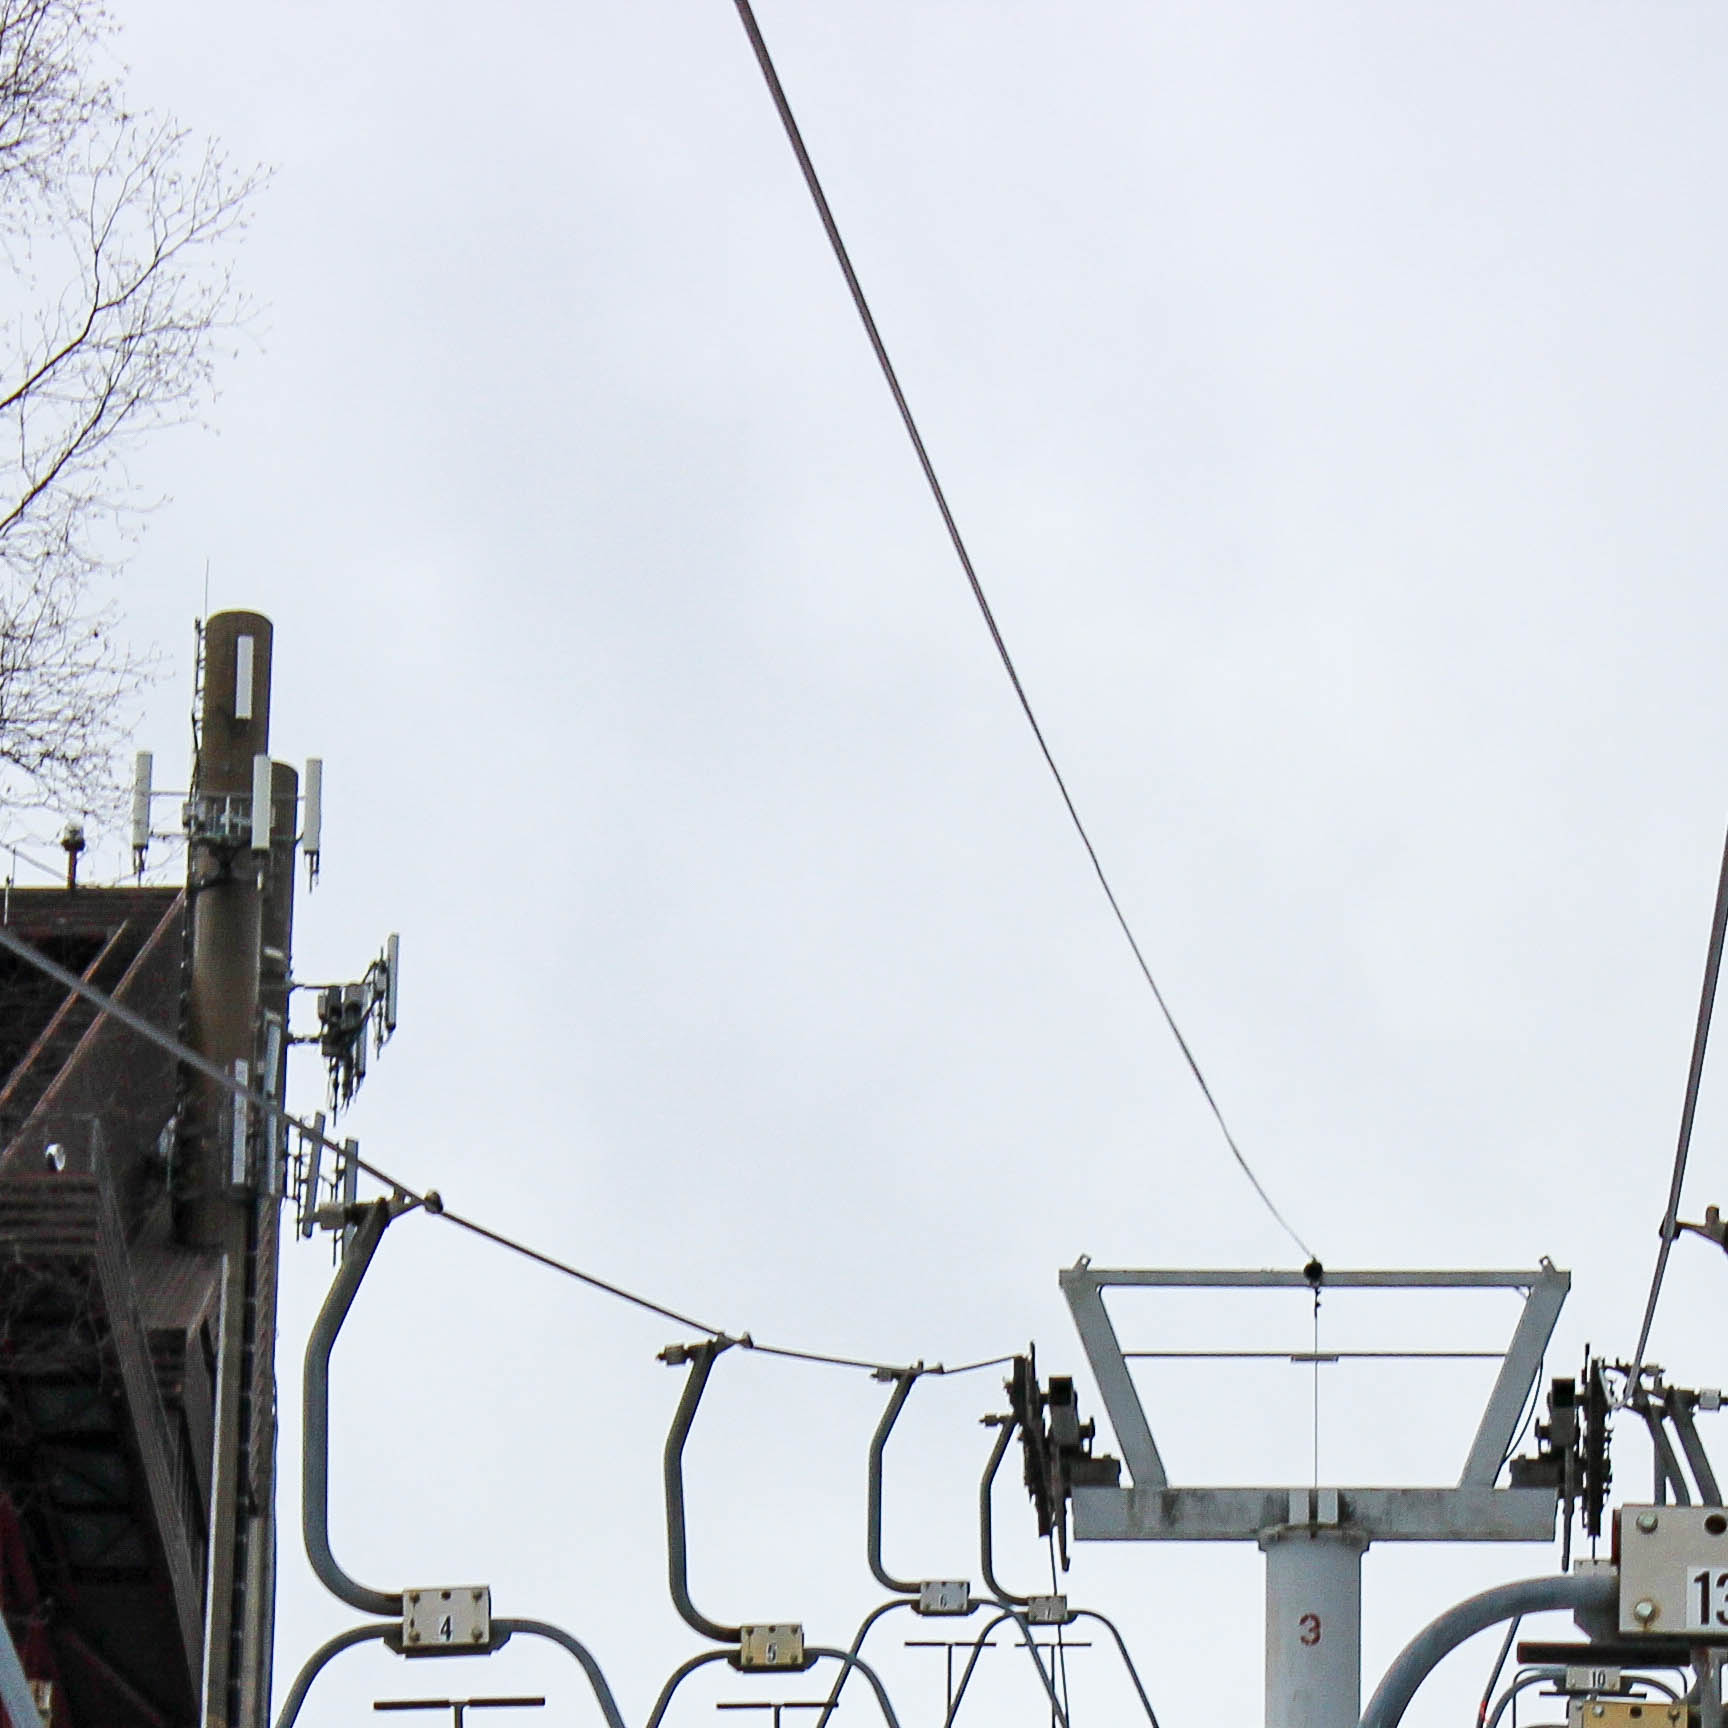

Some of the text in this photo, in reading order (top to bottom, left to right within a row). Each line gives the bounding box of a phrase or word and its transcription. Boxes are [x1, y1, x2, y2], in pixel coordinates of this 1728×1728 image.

[439, 1615, 453, 1642] 4
[1298, 1612, 1322, 1648] 3
[1591, 1671, 1606, 1688] 10
